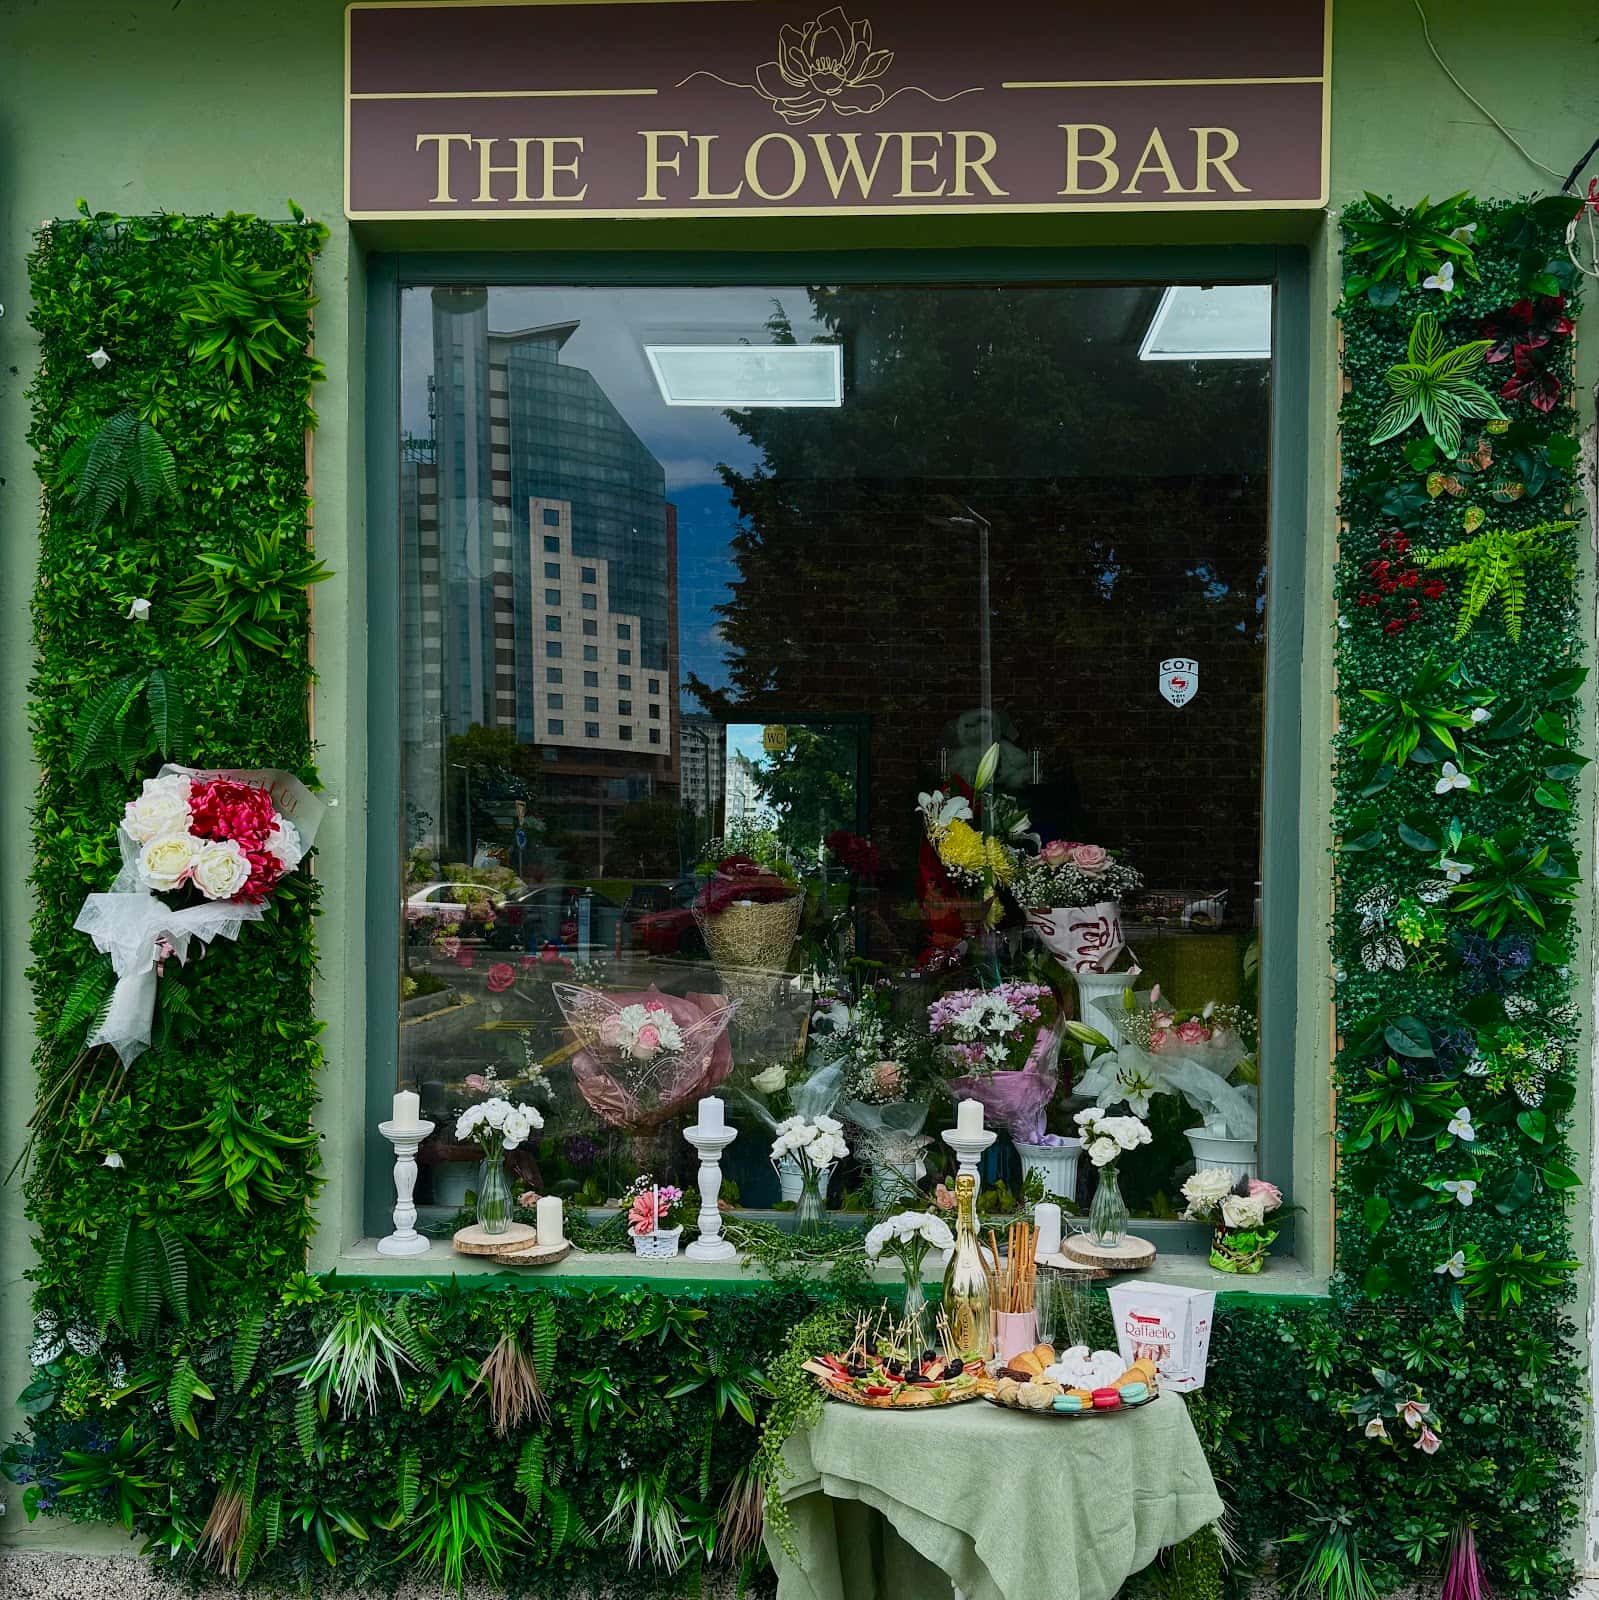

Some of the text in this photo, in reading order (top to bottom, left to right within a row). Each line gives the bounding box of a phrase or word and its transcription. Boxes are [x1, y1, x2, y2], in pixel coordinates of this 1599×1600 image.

[415, 123, 1253, 203] THE FLOWER BAR
[767, 733, 783, 745] WC
[1125, 1321, 1176, 1340] Raffaello
